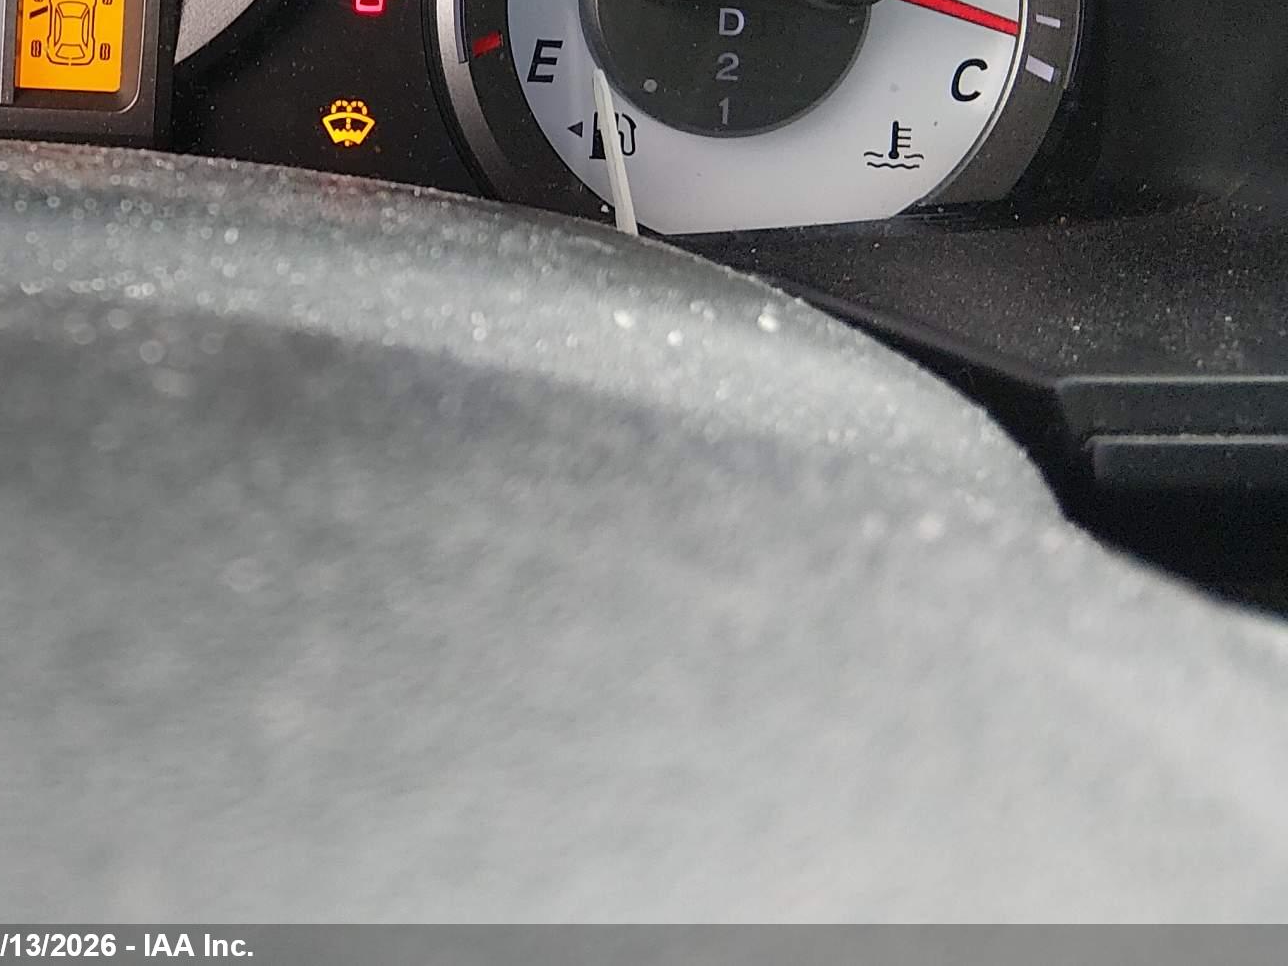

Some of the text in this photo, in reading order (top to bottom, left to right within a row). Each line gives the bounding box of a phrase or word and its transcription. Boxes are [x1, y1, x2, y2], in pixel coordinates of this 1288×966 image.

[719, 7, 745, 35] D
[527, 40, 563, 83] E
[716, 55, 739, 81] 2
[951, 60, 988, 101] C
[718, 97, 730, 125] 1
